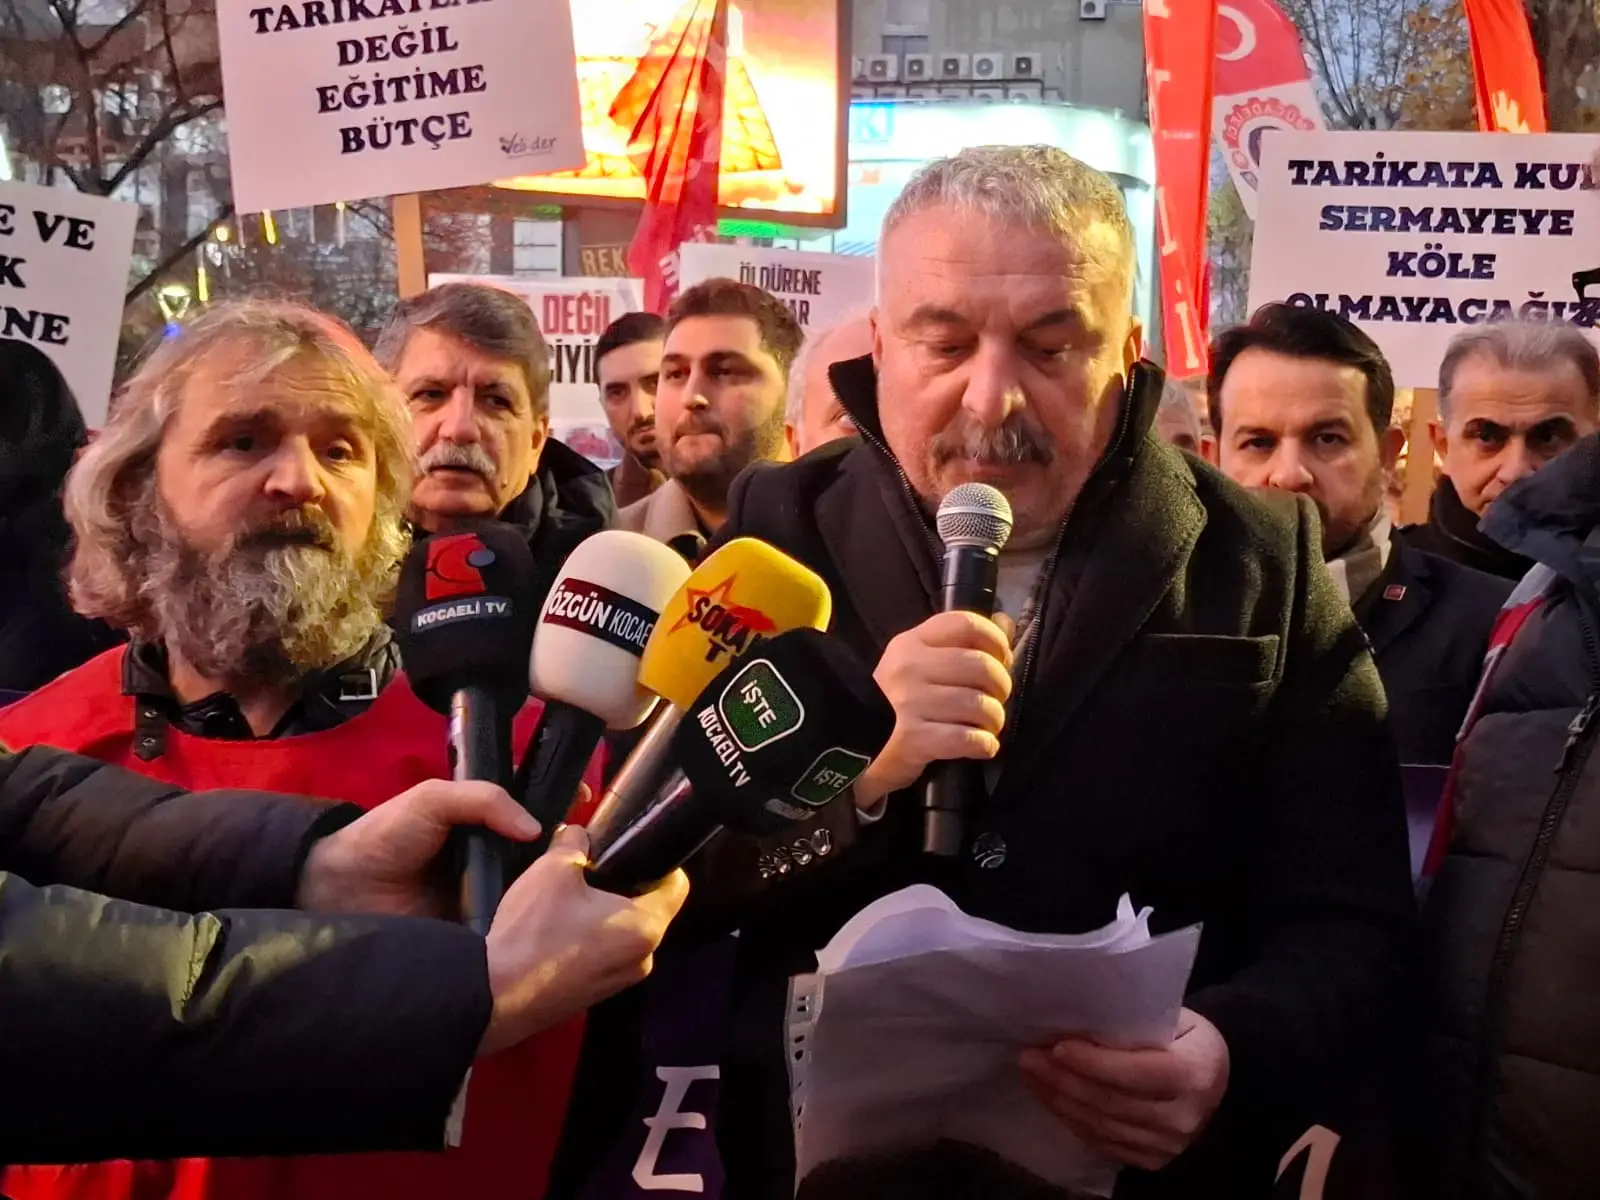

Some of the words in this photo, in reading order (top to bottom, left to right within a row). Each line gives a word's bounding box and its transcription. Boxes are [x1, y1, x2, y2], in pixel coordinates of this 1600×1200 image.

[337, 22, 459, 67] DEĞİL
[316, 65, 487, 113] EĞİTİME
[340, 112, 473, 154] BÜTÇE
[1288, 152, 1503, 188] TARİKATA
[32, 211, 96, 251] VE
[1319, 205, 1575, 236] SERMAYEYE
[1386, 243, 1497, 279] KÖLE
[0, 306, 70, 345] NE
[417, 599, 480, 627] KOCAELİ
[485, 601, 507, 614] TV
[548, 584, 613, 628] ÖZGÜN
[740, 679, 777, 729] İŞTE
[728, 760, 752, 787] TV
